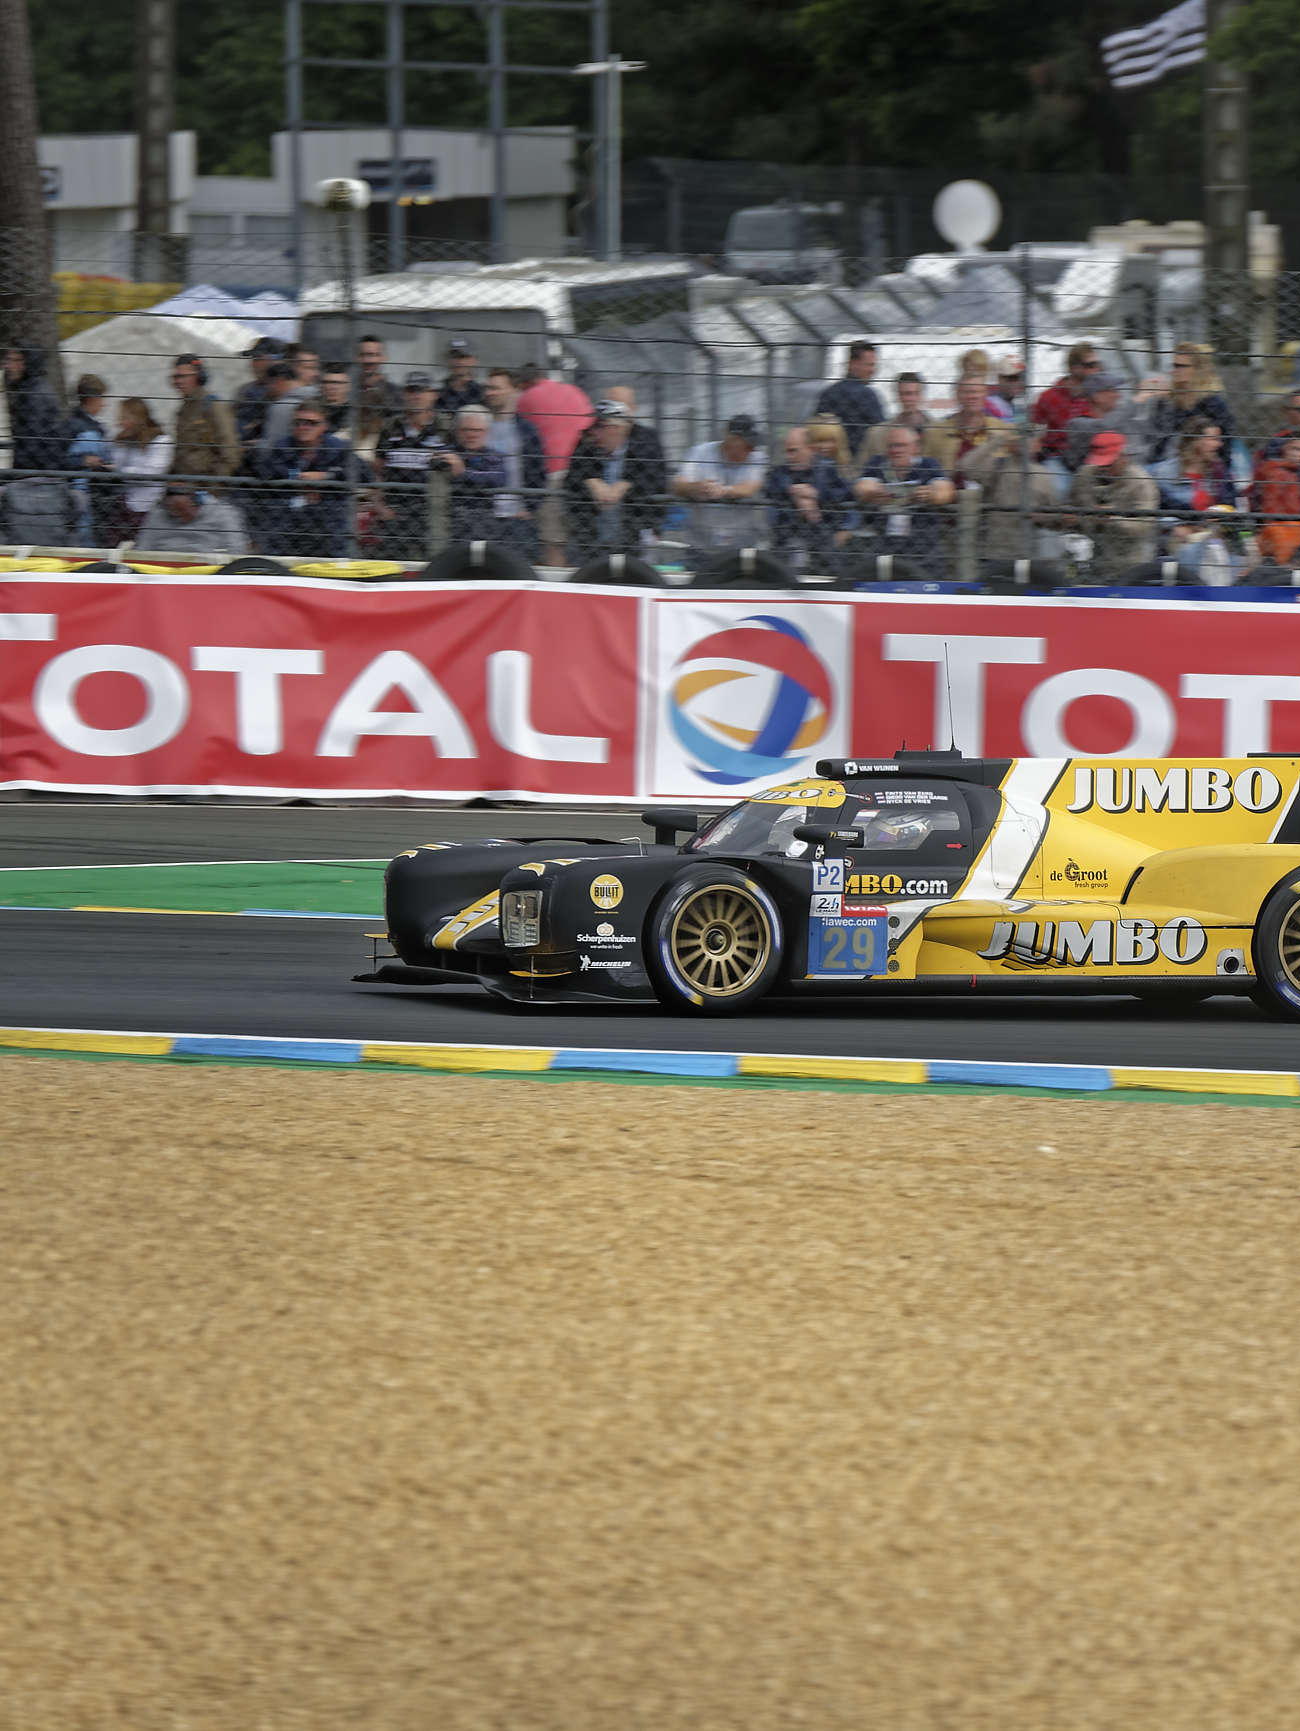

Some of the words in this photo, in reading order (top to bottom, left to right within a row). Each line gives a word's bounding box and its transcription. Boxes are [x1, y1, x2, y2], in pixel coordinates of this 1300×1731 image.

[0, 613, 609, 764] OTAL
[1066, 767, 1283, 814] JUMBO
[817, 866, 841, 886] P2
[1050, 870, 1063, 881] de
[1064, 859, 1108, 882] Groot
[576, 934, 637, 944] Scherpenhuizen
[822, 928, 875, 970] 29
[976, 916, 1209, 966] JUMBO
